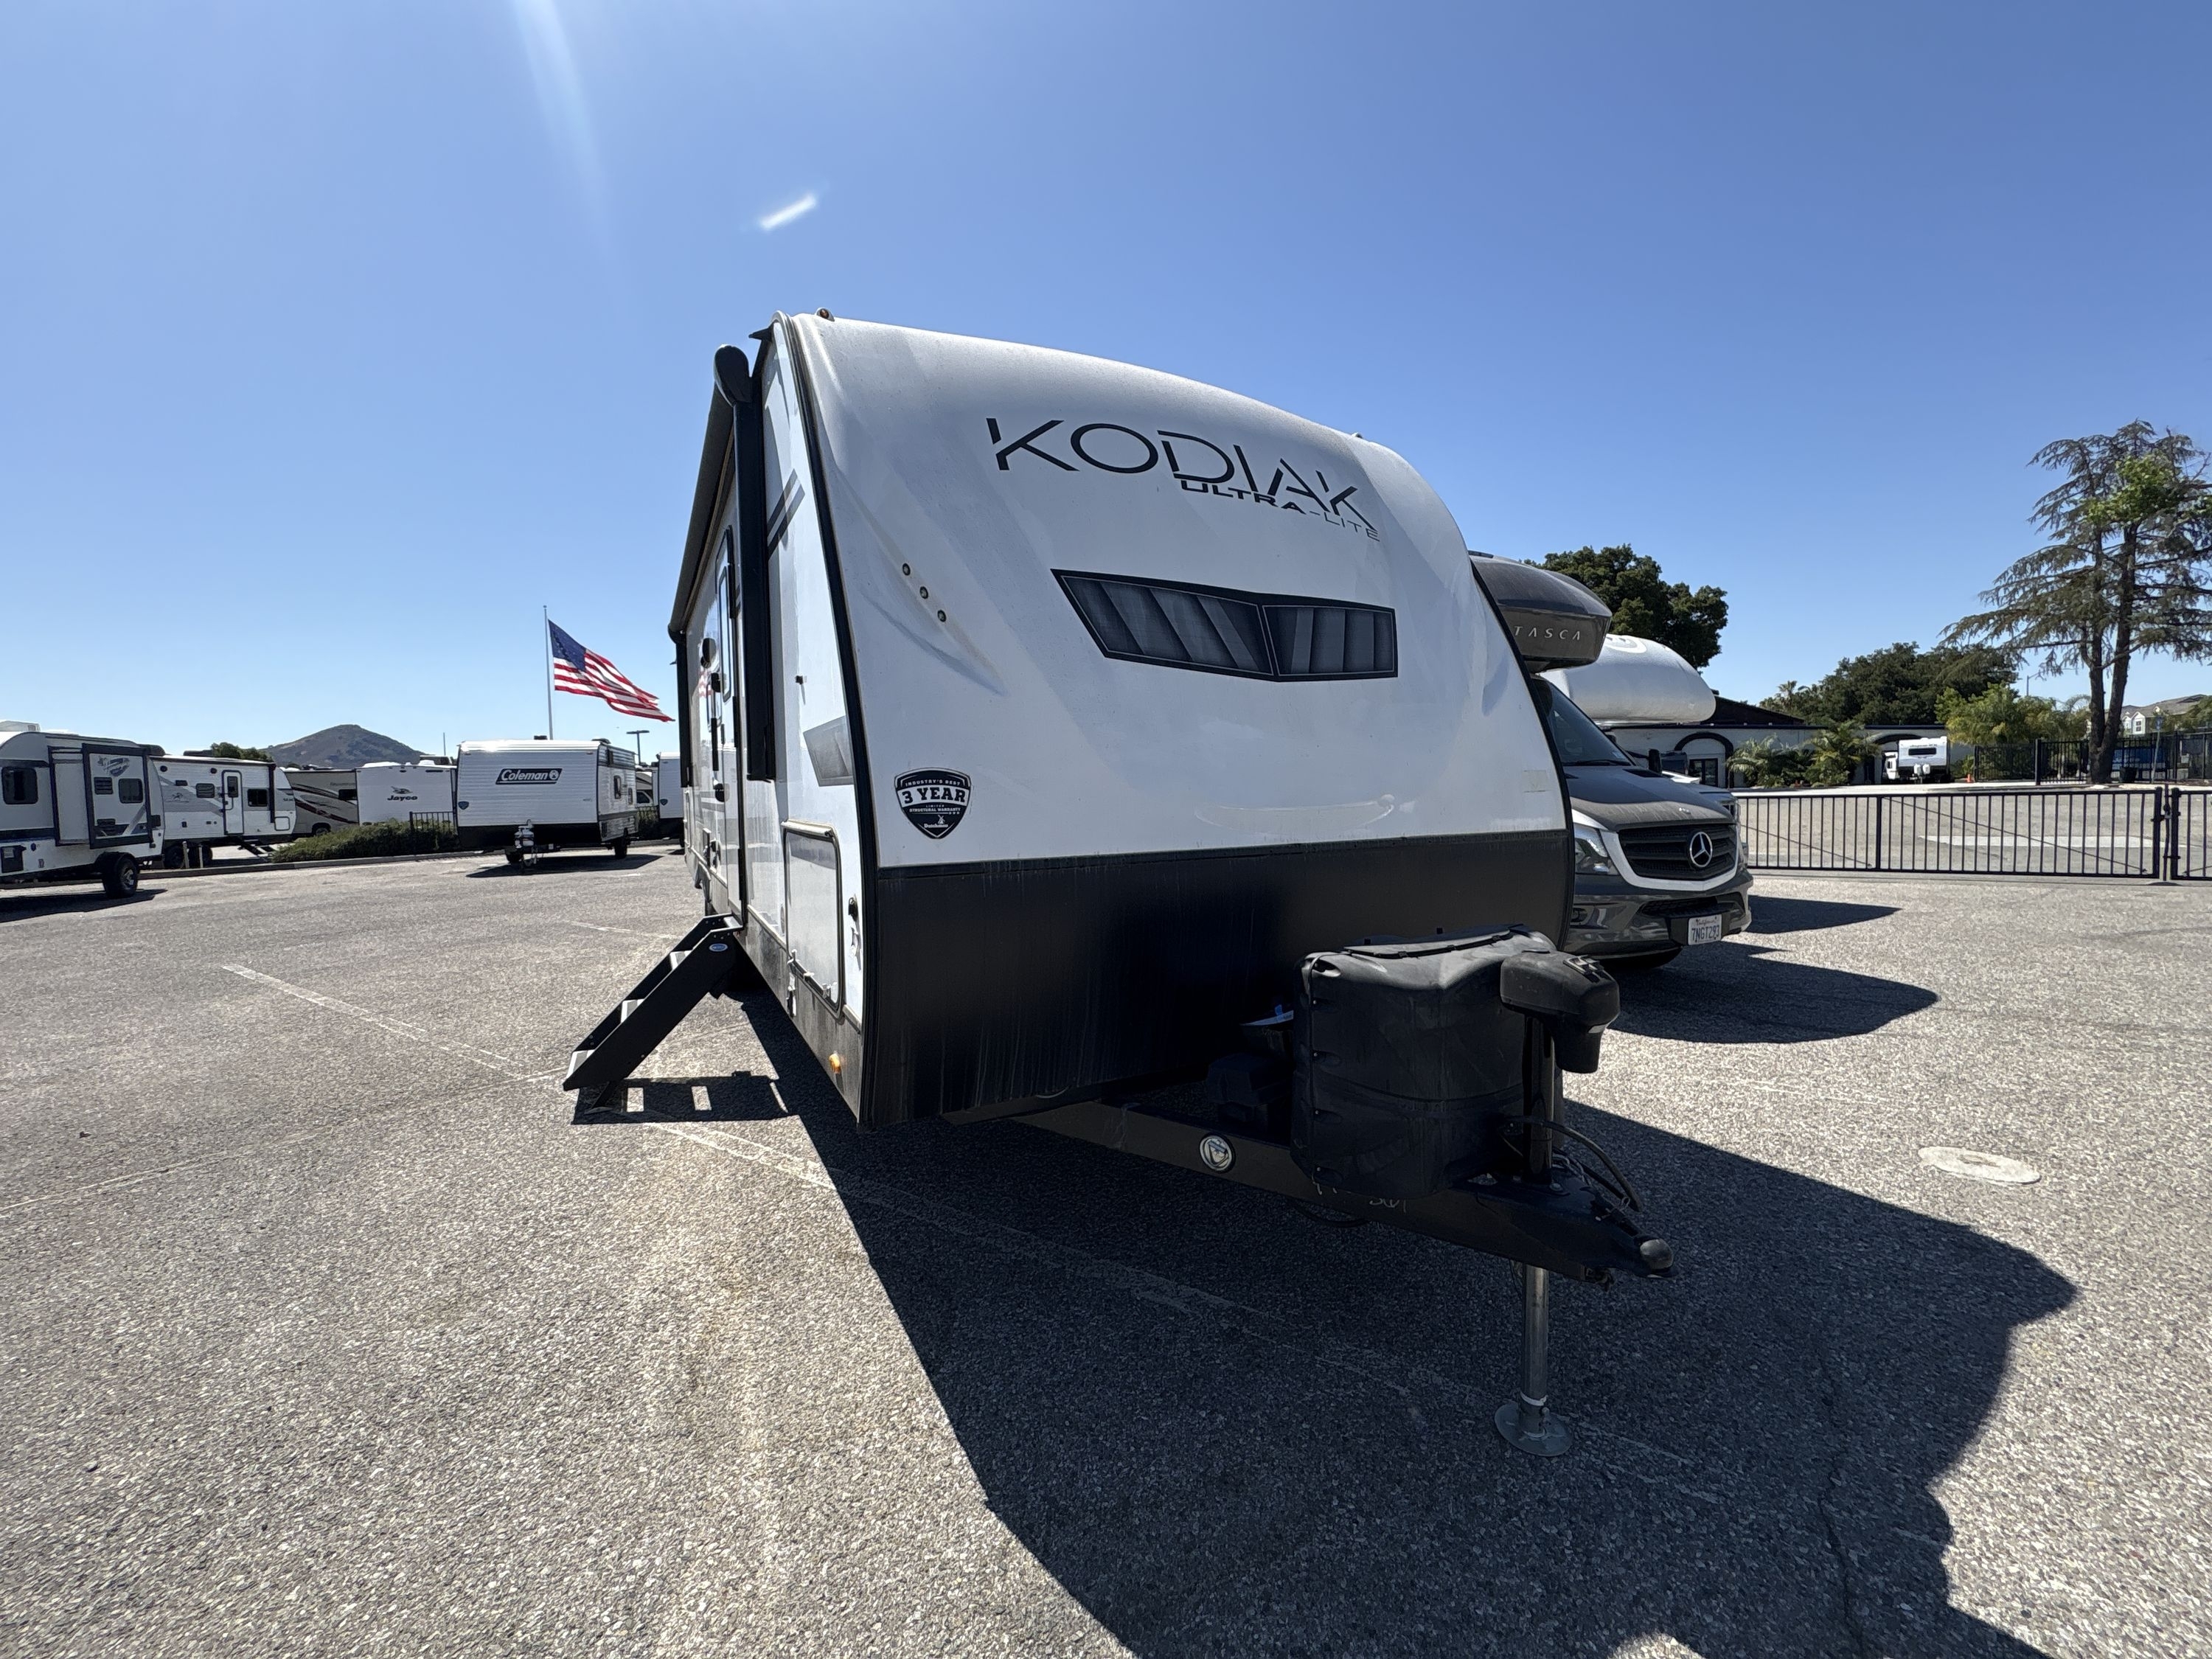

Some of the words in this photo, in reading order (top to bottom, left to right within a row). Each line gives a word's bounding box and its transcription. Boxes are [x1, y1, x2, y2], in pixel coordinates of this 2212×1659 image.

[986, 417, 1378, 531] KODIAK
[1180, 479, 1381, 542] ULTRA-LITE
[501, 769, 549, 781] Coleman
[902, 790, 914, 804] 3
[917, 787, 966, 803] YEAR
